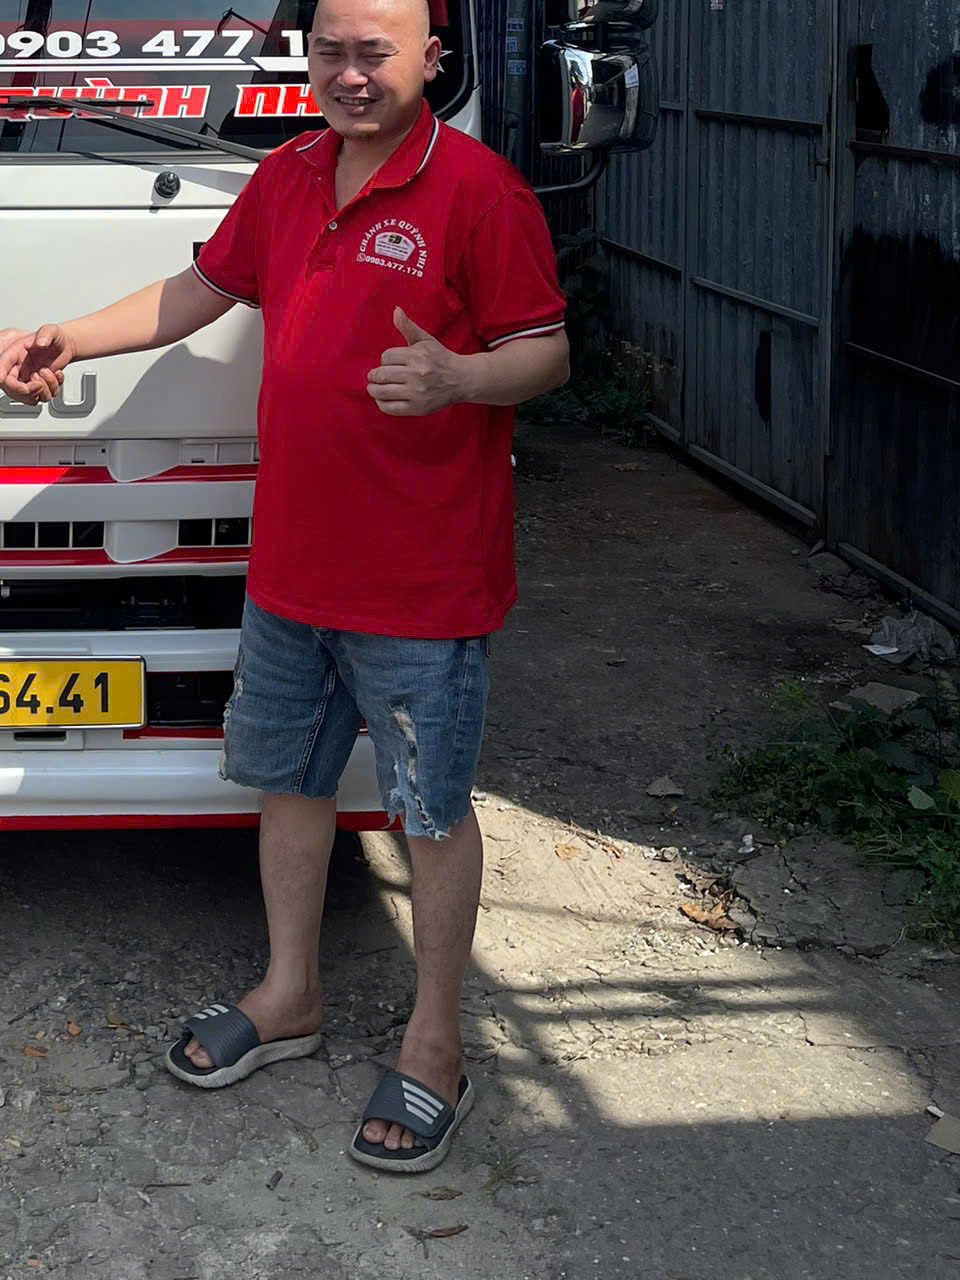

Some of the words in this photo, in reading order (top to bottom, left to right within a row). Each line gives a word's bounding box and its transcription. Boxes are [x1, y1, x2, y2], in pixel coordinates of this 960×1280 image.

[141, 30, 254, 58] 477
[281, 30, 304, 57] 1
[234, 83, 325, 118] NH
